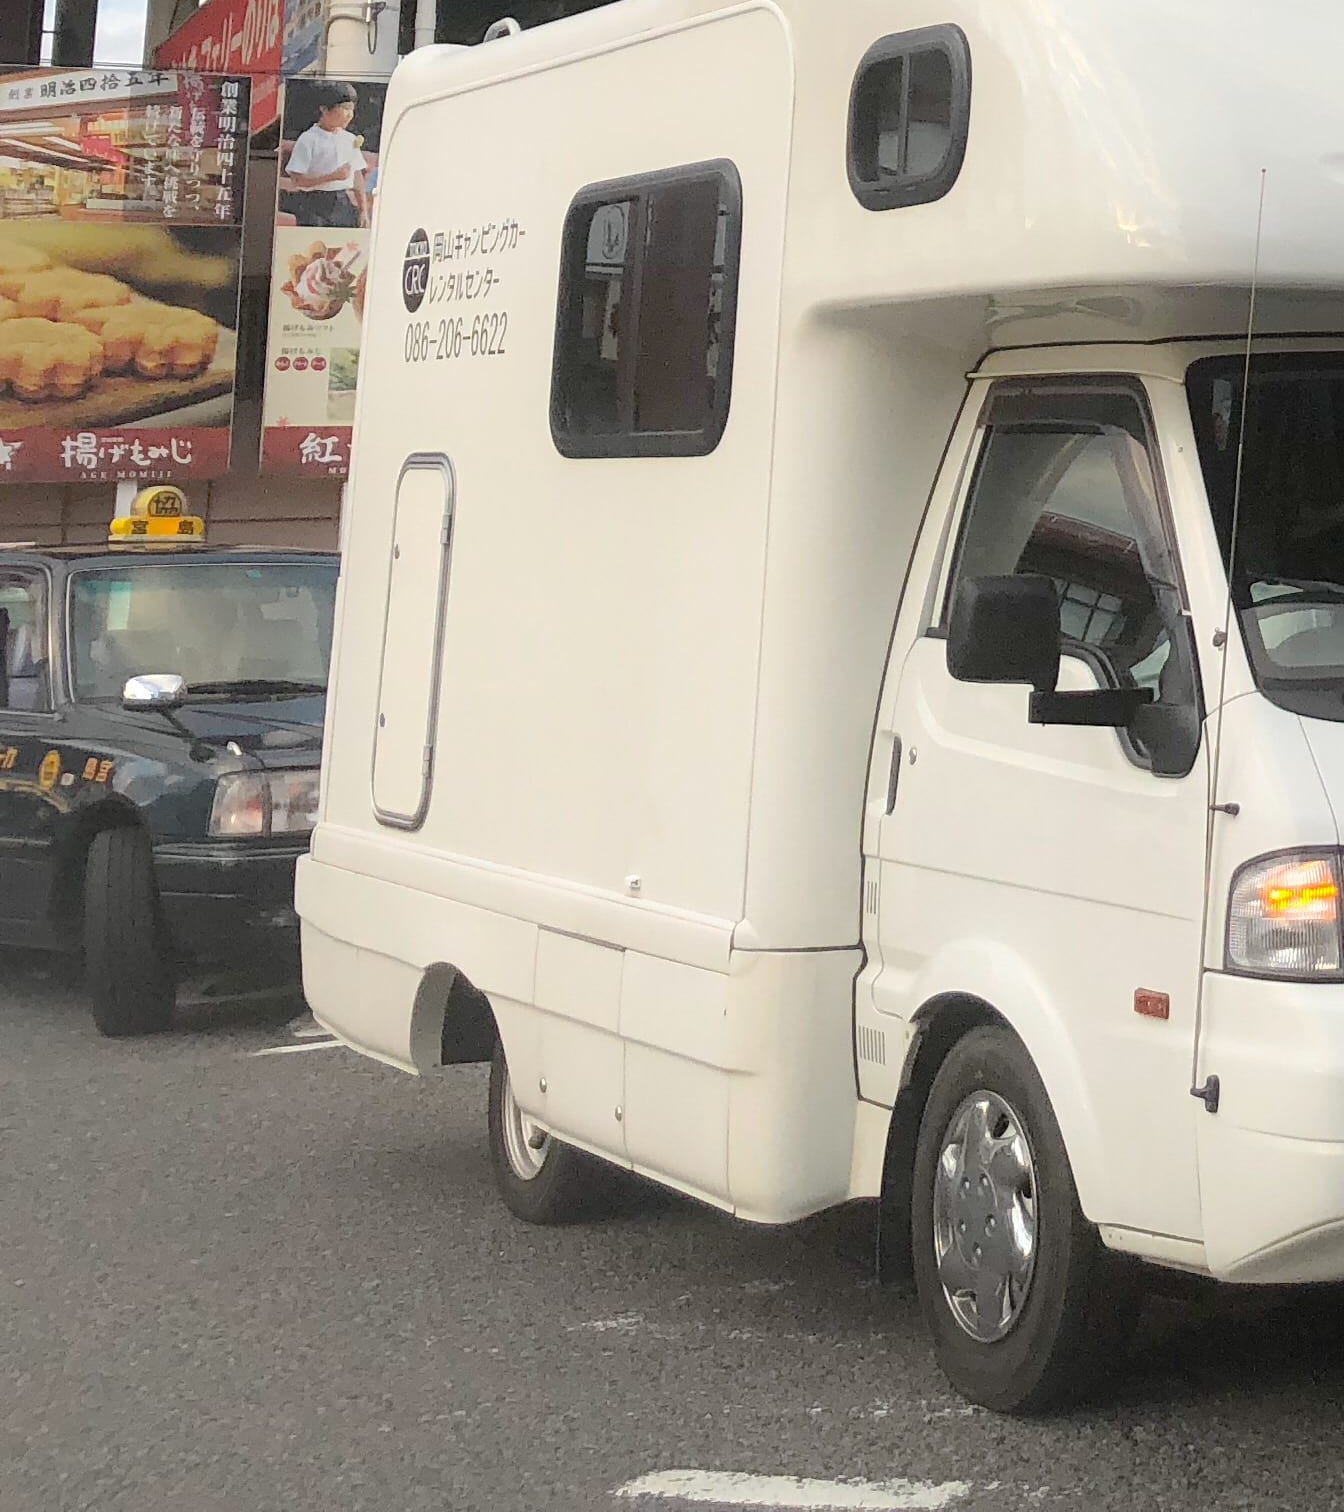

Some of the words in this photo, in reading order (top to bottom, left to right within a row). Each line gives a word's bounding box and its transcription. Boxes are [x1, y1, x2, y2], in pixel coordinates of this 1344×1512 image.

[214, 81, 240, 221] 創業明治四十五年
[432, 218, 526, 263] 岡山キャンピングカー
[405, 264, 426, 295] CRC
[429, 267, 500, 305] レンタルセンター
[404, 312, 508, 363] 086-206-6622
[60, 432, 193, 468] 揚げもみじ
[300, 432, 352, 465] 紅
[79, 470, 109, 479] AGE
[116, 469, 173, 479] MOMIJI
